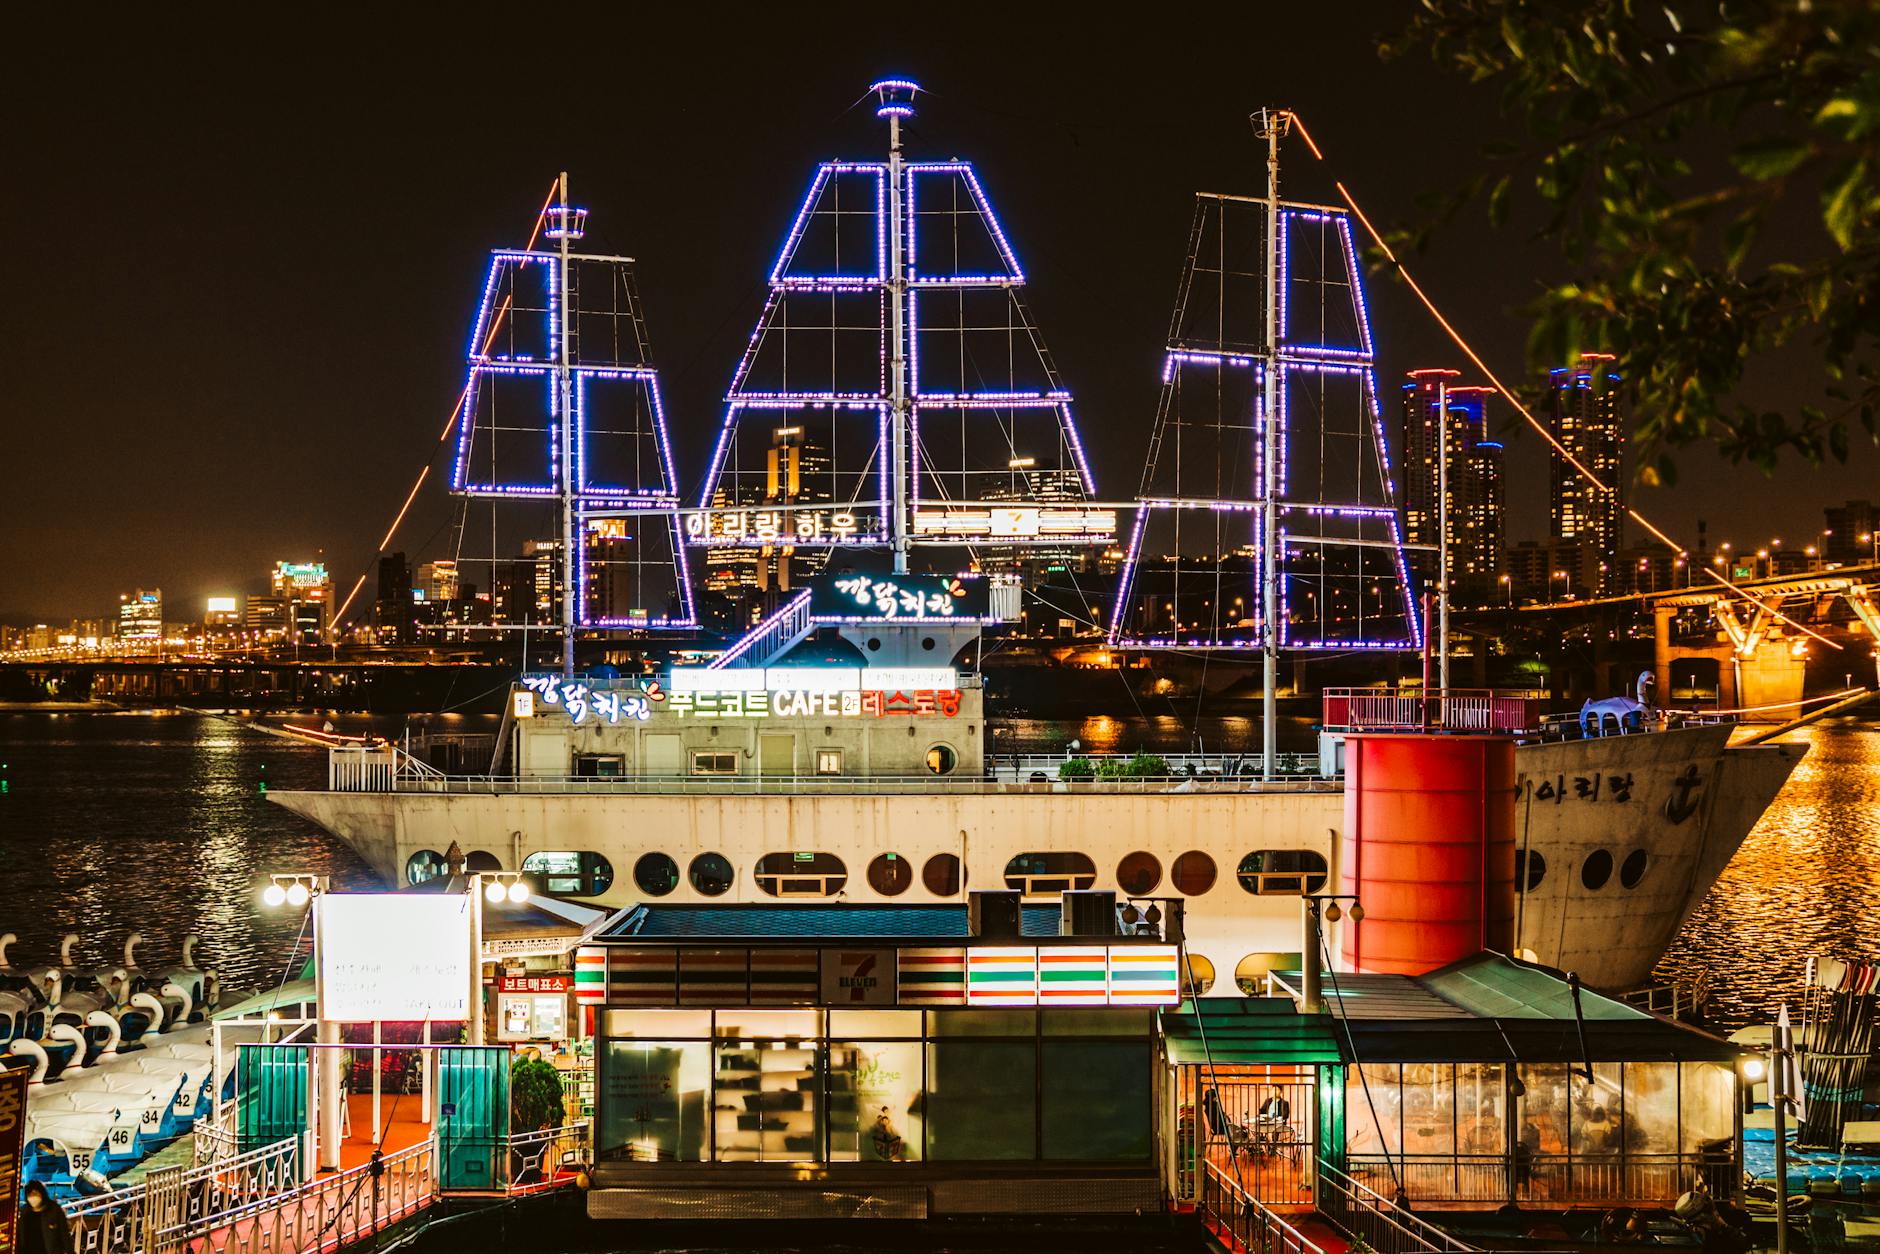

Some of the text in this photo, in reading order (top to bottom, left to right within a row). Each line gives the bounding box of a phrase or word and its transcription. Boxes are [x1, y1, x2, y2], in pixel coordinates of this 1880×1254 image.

[686, 512, 782, 542] 아리랑
[669, 690, 769, 718] 푸드코트
[773, 689, 840, 716] CAFE
[862, 689, 962, 717] 레스토랑
[1535, 772, 1634, 804] 아리랑
[840, 952, 877, 1001] 7
[503, 978, 564, 992] 보트매표소
[175, 1094, 190, 1107] 42
[142, 1110, 158, 1124] 34
[112, 1130, 128, 1144] 46
[72, 1154, 90, 1169] 55
